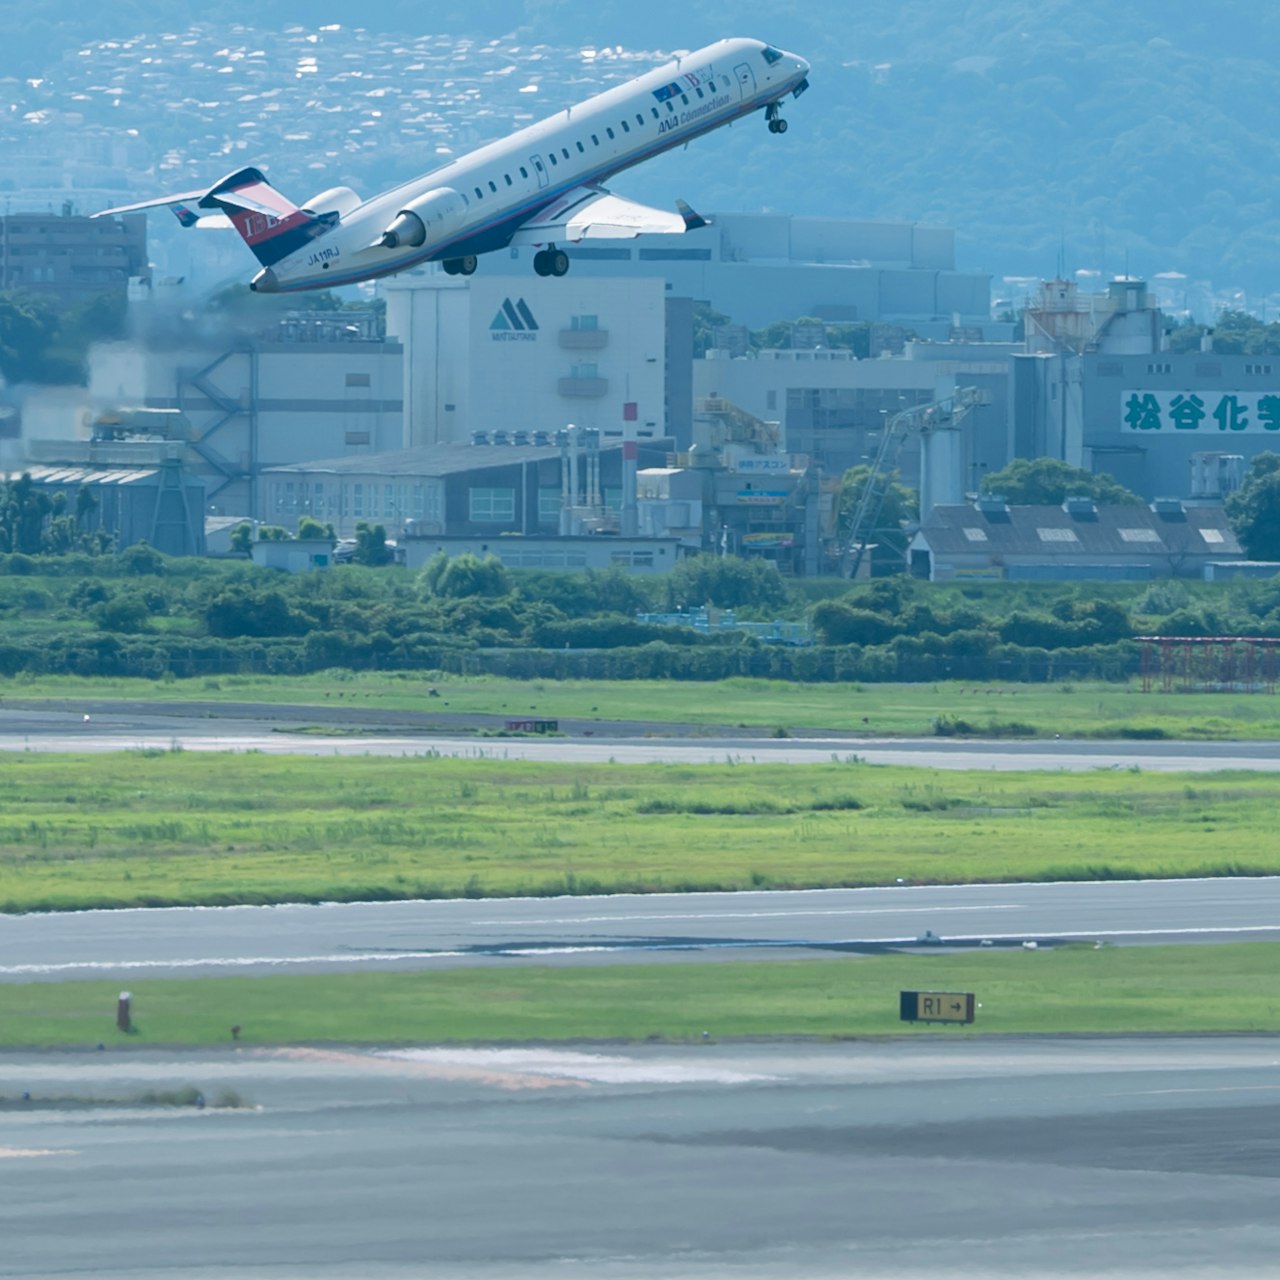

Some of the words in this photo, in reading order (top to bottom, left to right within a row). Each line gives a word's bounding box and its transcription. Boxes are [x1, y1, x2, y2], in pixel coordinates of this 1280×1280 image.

[658, 115, 679, 136] ANA
[680, 94, 731, 124] Connection
[308, 246, 340, 266] JA11RJ
